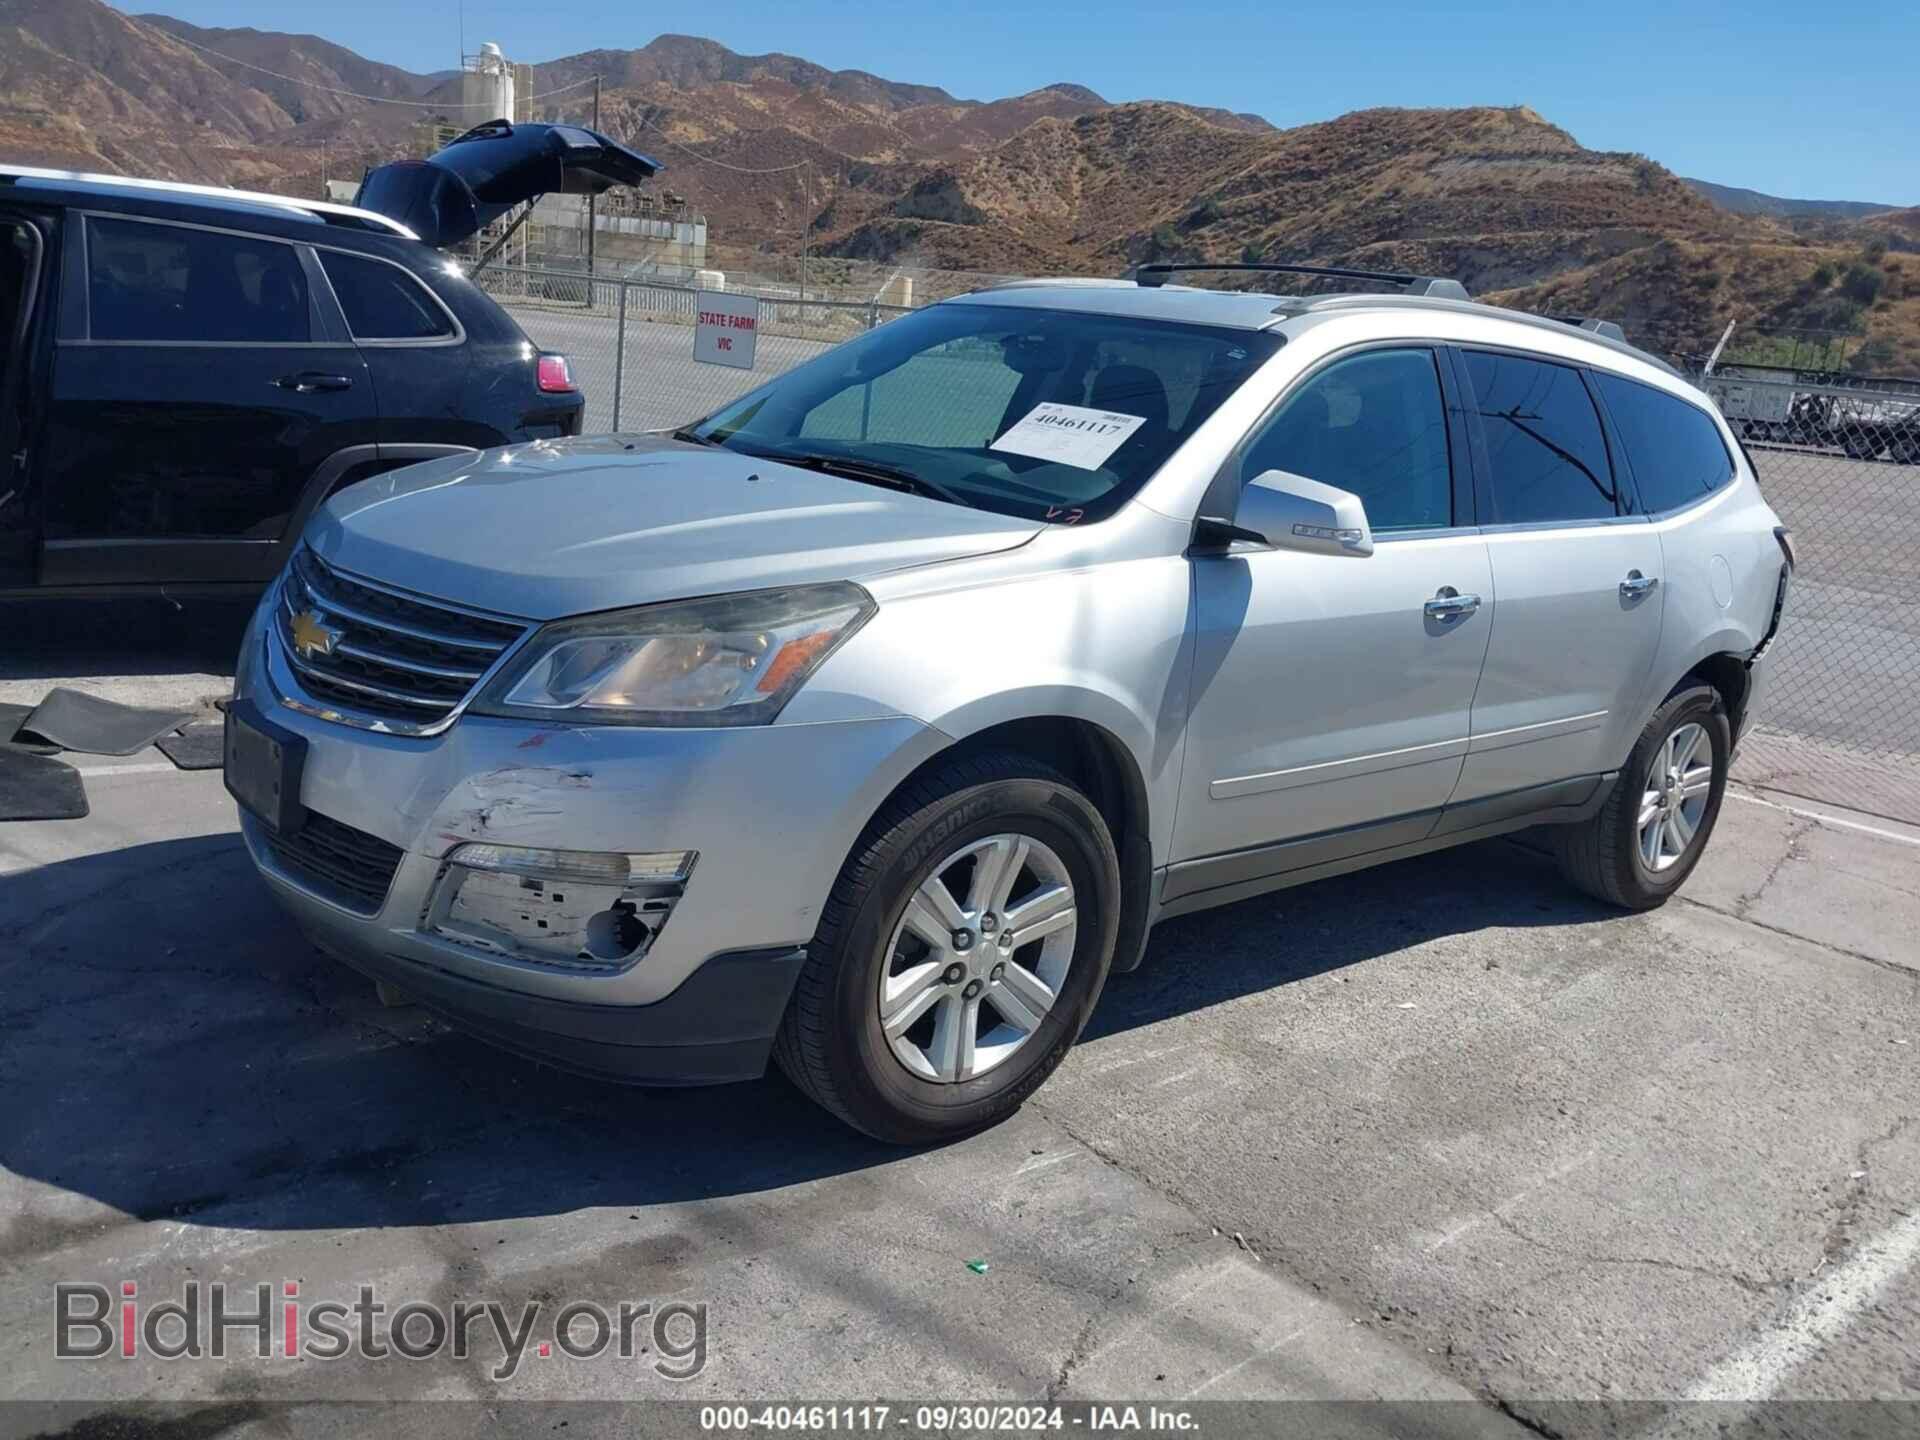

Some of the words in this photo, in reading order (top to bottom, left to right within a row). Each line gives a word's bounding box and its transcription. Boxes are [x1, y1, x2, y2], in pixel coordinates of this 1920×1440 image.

[699, 311, 726, 327] STATE
[728, 315, 755, 330] FARM
[717, 337, 733, 351] VIC
[1034, 414, 1121, 436] 40461117
